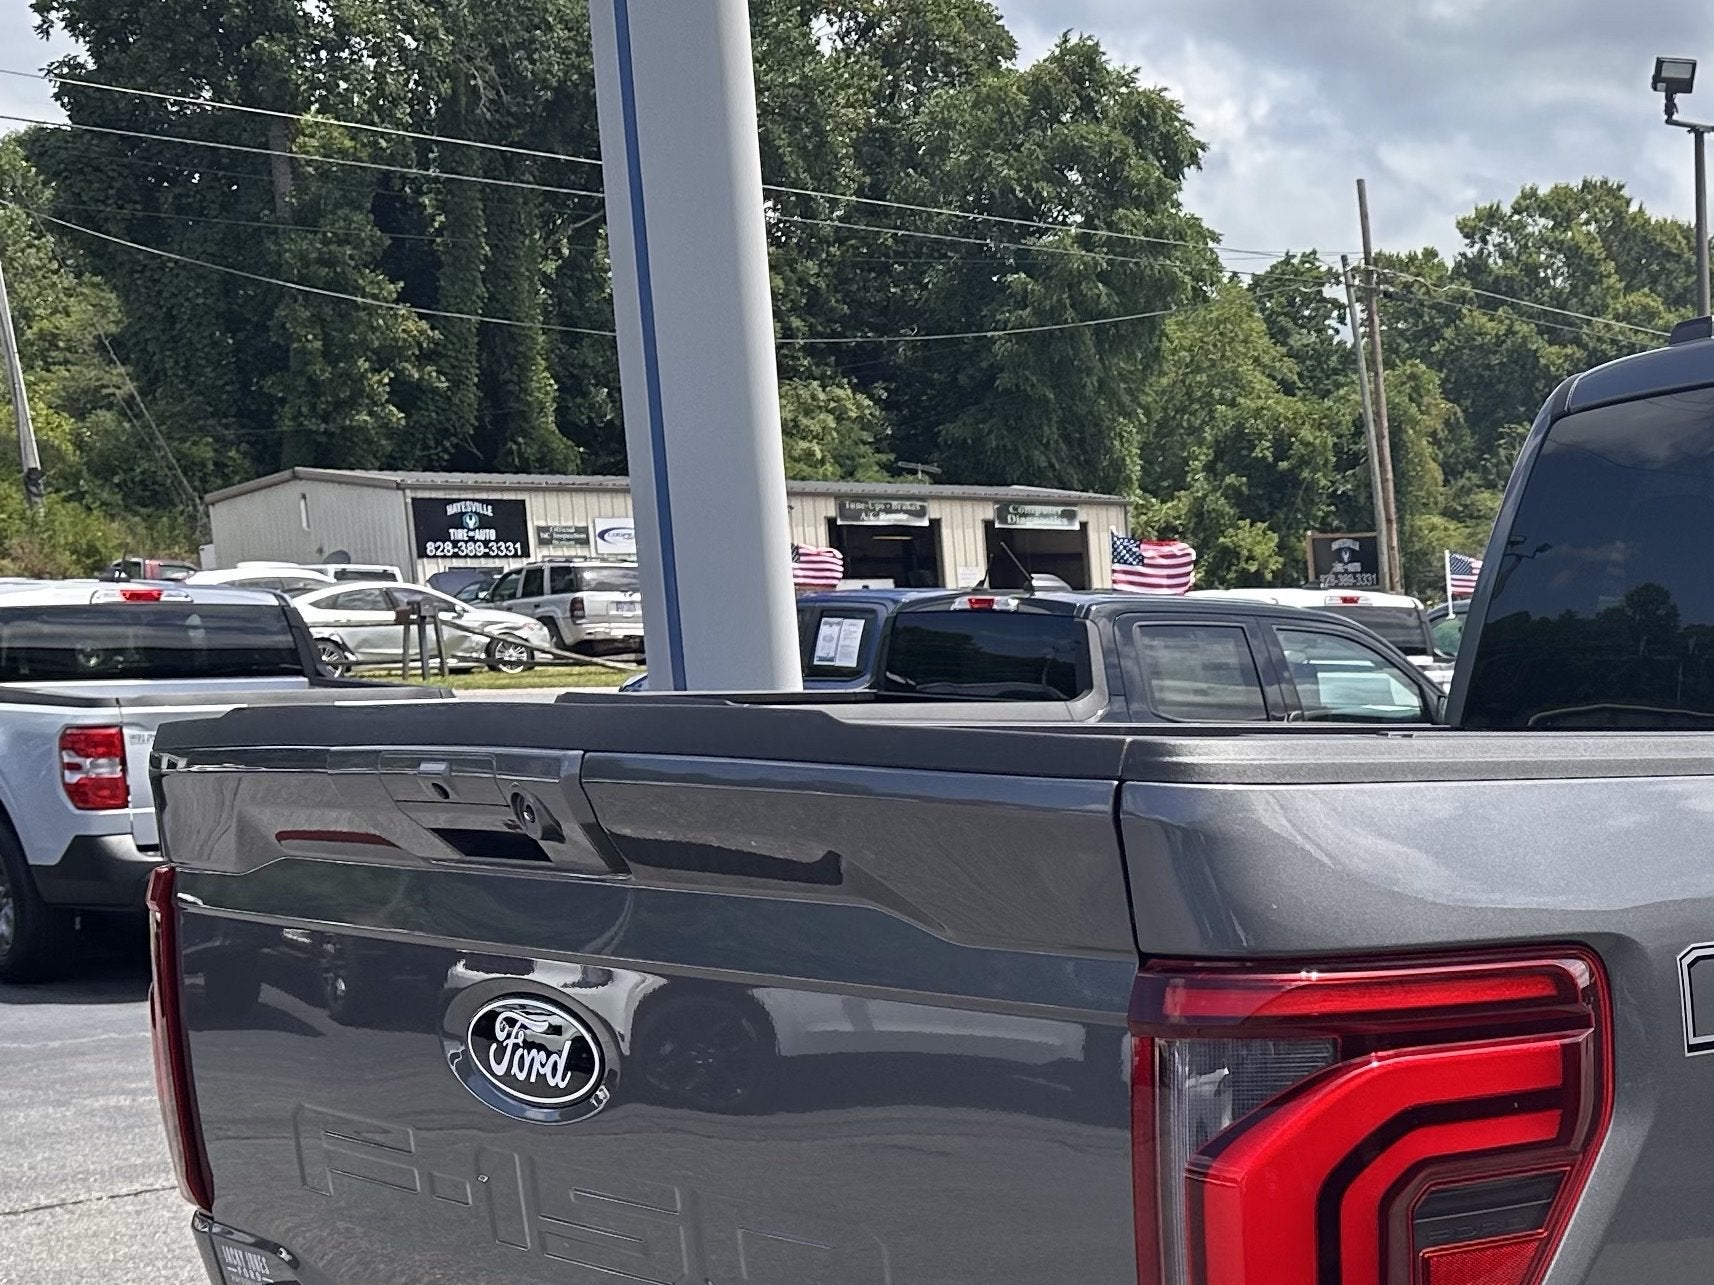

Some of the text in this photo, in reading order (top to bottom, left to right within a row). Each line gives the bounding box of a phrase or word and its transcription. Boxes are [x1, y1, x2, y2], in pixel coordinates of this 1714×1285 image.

[446, 501, 494, 517] HAYESVILLE
[1008, 504, 1062, 516] Computer
[448, 528, 469, 541] TIRE
[474, 528, 496, 541] AUTO
[426, 541, 522, 557] 828-389-3331
[488, 1010, 573, 1089] Ford
